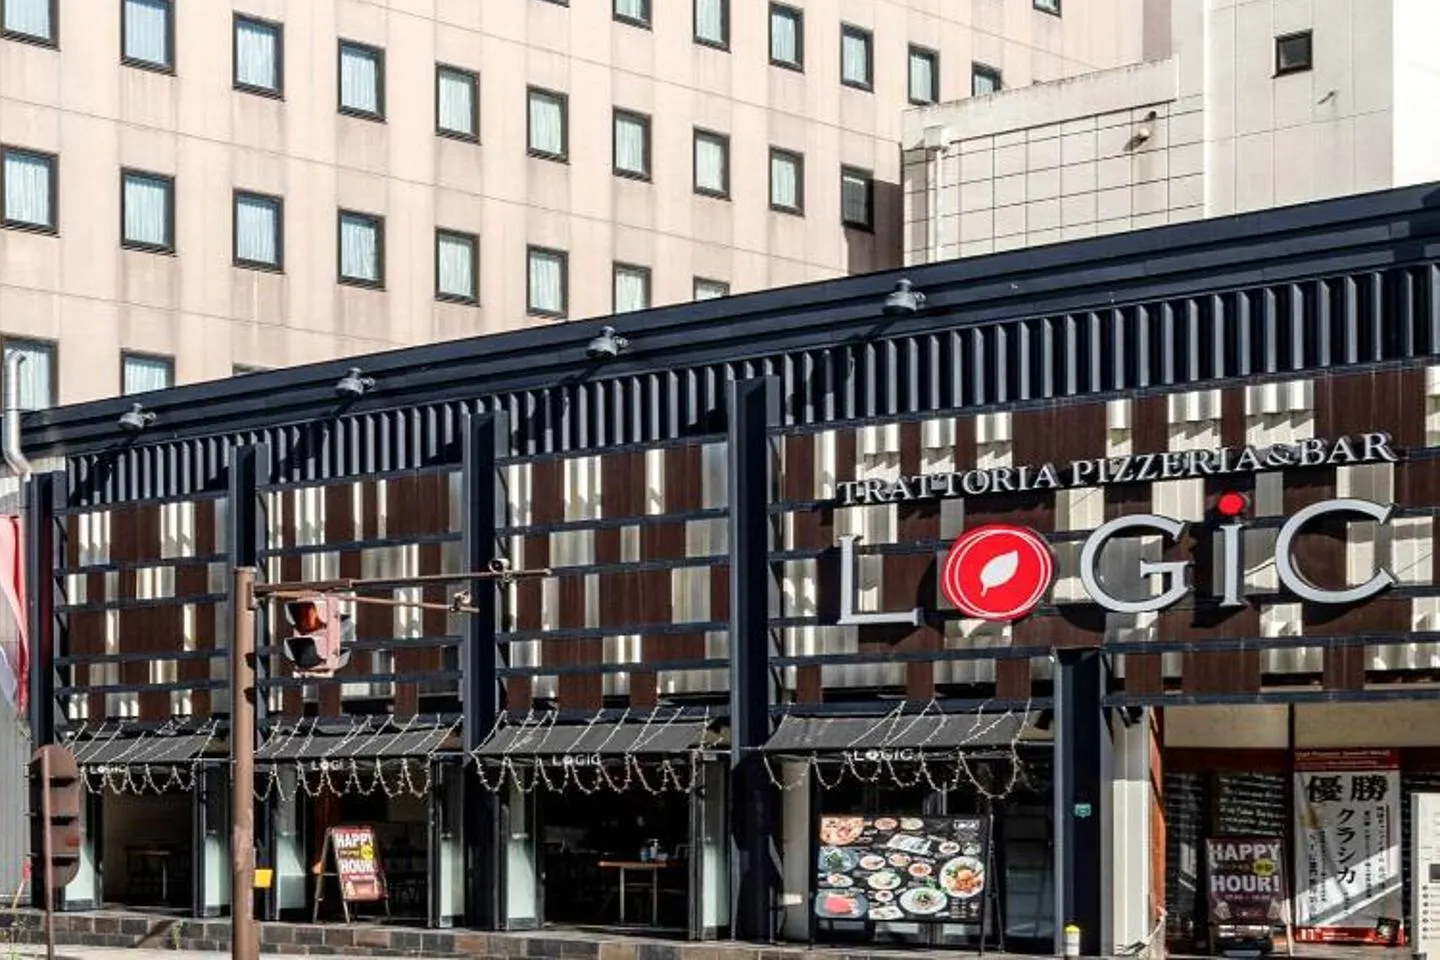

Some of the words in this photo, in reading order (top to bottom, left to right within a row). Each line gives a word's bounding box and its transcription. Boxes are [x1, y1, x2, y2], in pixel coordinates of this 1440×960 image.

[836, 463, 1061, 505] TRATTORIA
[1069, 431, 1398, 487] PIZZERIA&BAR
[334, 831, 373, 848] HAPPY
[1210, 843, 1280, 861] HAPPY
[1210, 874, 1280, 892] HOUR!
